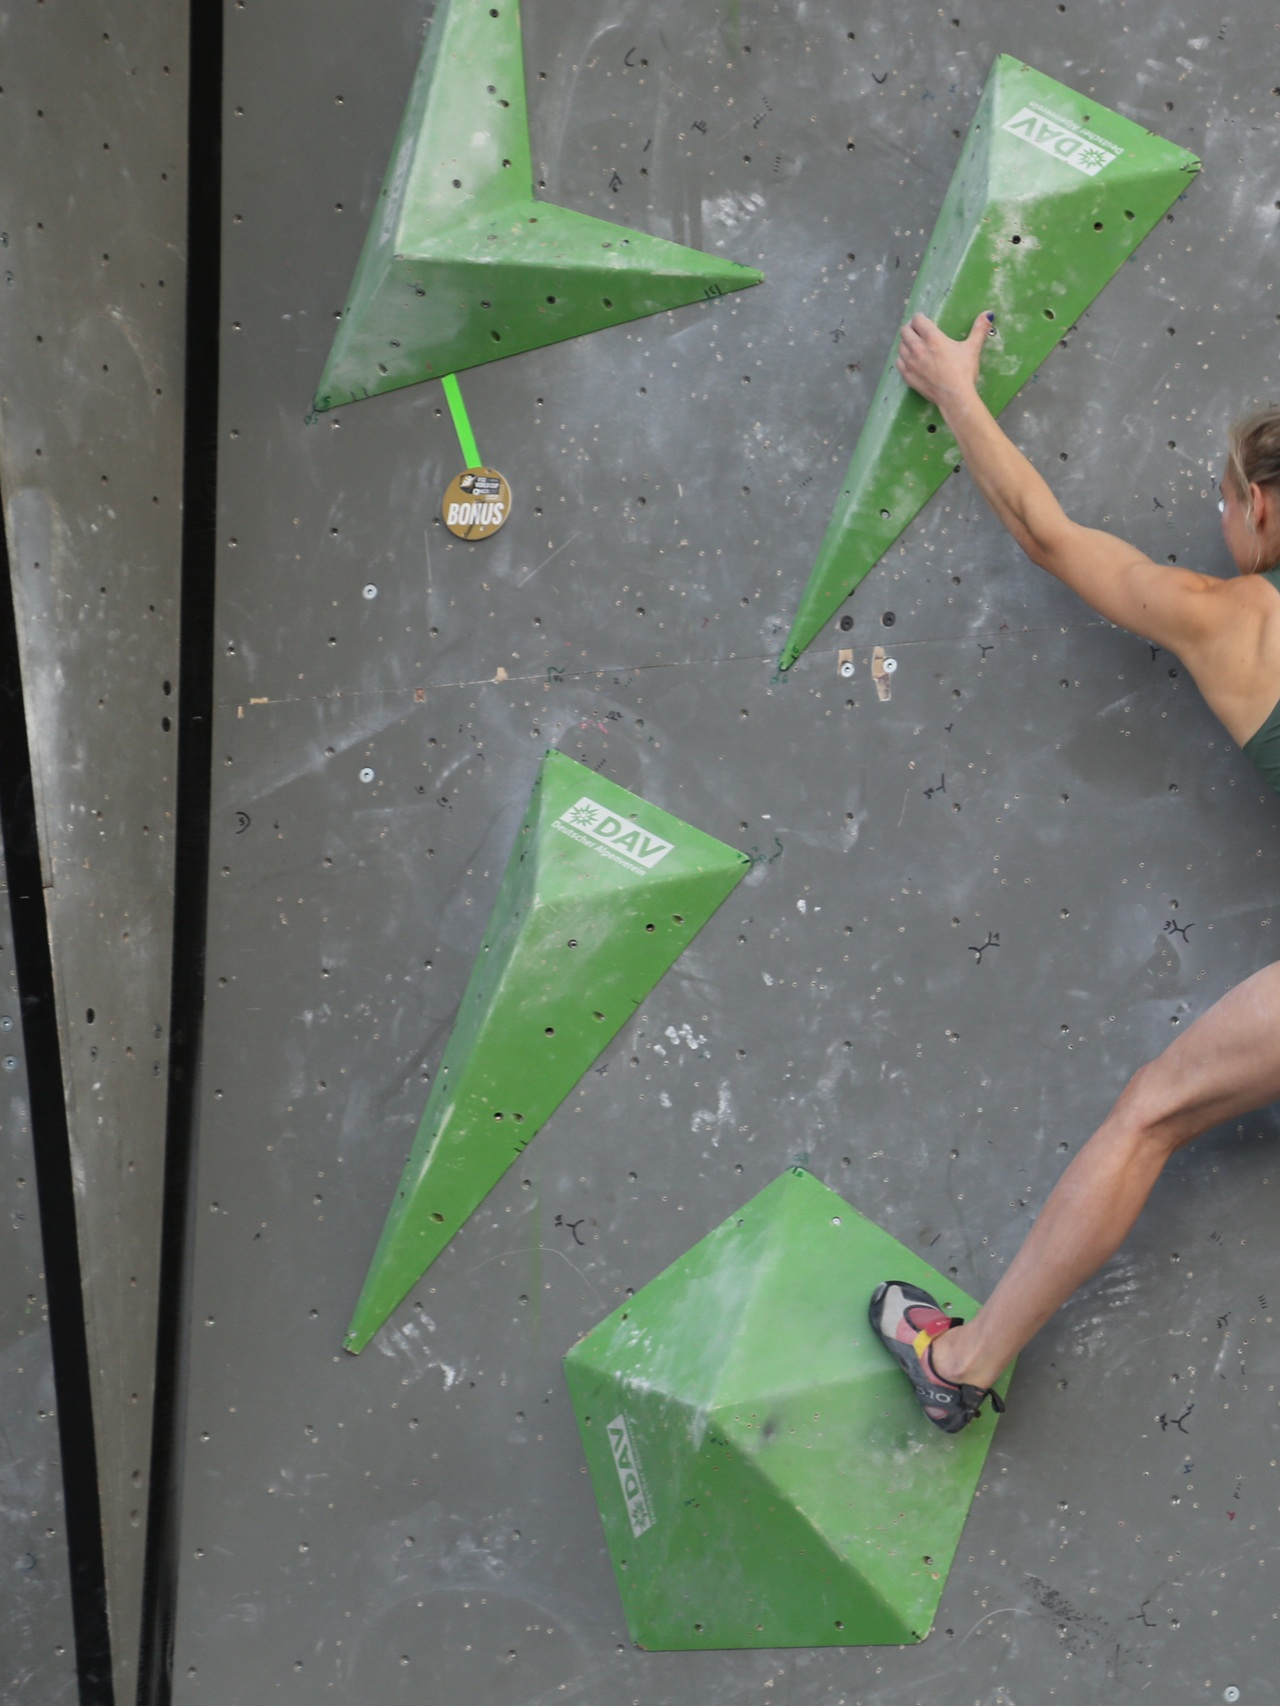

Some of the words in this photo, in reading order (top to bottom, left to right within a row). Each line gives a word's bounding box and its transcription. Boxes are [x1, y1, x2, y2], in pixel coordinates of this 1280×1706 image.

[1009, 117, 1084, 158] DAV
[446, 502, 505, 525] BONUS
[551, 820, 597, 848] Deutscher
[593, 844, 646, 876] Alpenverein
[592, 815, 668, 858] DAV
[609, 1428, 639, 1500] DAV
